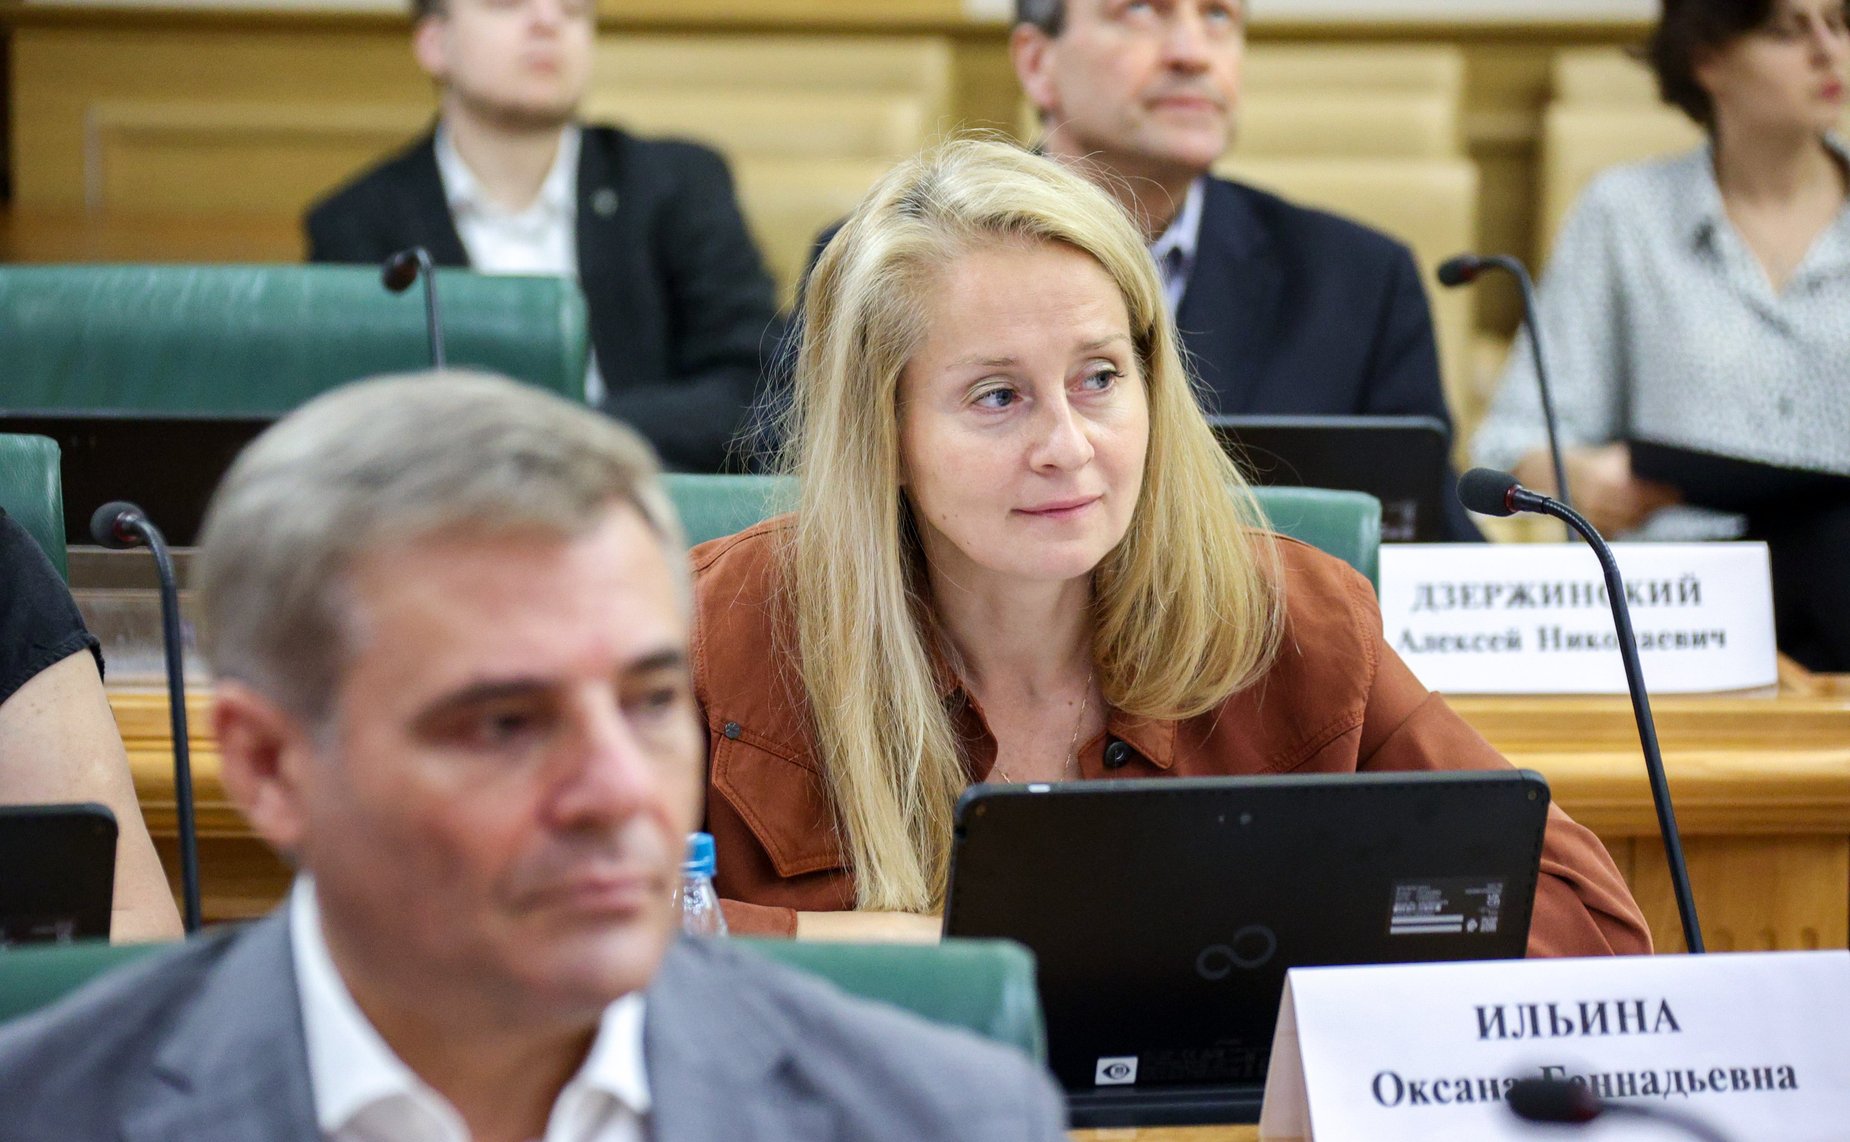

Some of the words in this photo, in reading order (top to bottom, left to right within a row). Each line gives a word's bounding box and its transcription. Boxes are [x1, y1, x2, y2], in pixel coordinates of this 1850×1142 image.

[1399, 628, 1523, 654] Алексей
[1537, 627, 1727, 653] Никоаевич
[1475, 998, 1682, 1041] ИЛЬИНА
[1371, 1070, 1524, 1108] Оксана
